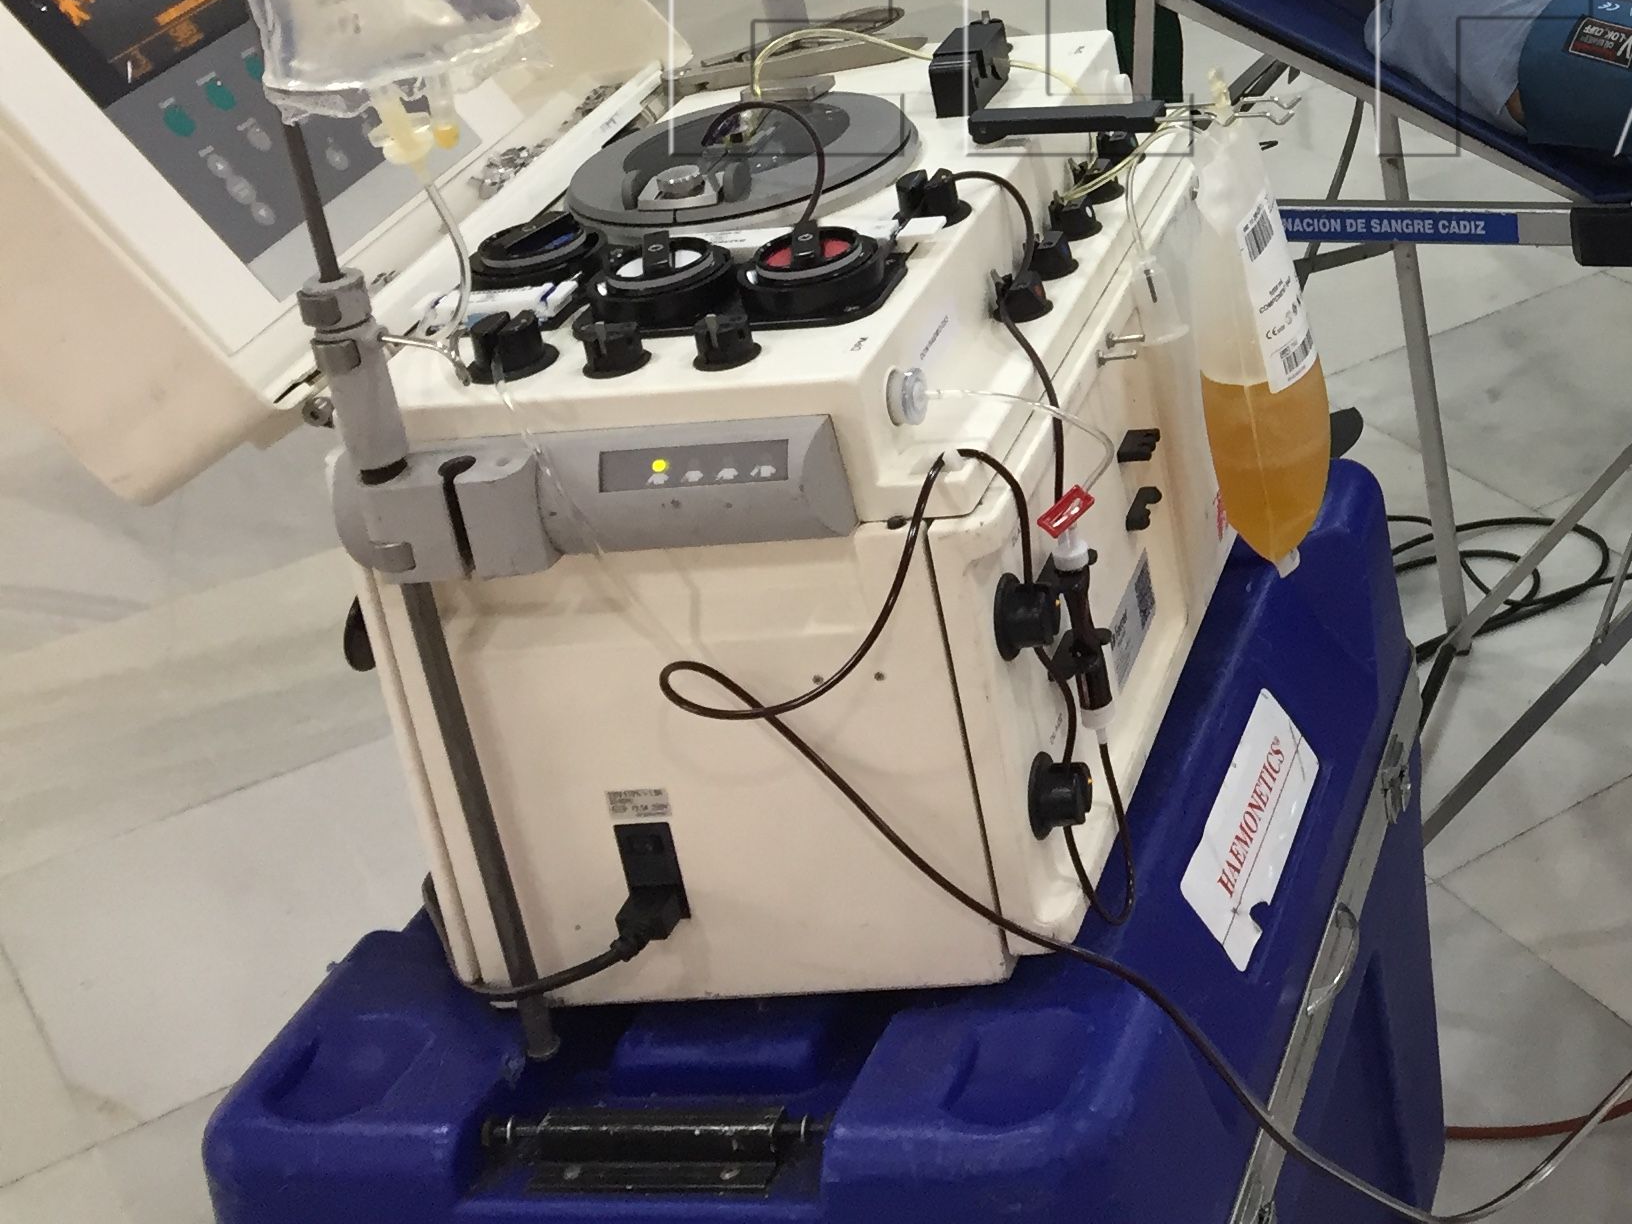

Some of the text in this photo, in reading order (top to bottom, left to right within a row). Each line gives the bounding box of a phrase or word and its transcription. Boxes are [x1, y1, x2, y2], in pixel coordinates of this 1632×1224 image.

[1583, 24, 1605, 37] CUFF
[1345, 218, 1367, 232] DE
[1370, 218, 1435, 234] SANGRE
[1217, 738, 1285, 898] HAEMONETICS
